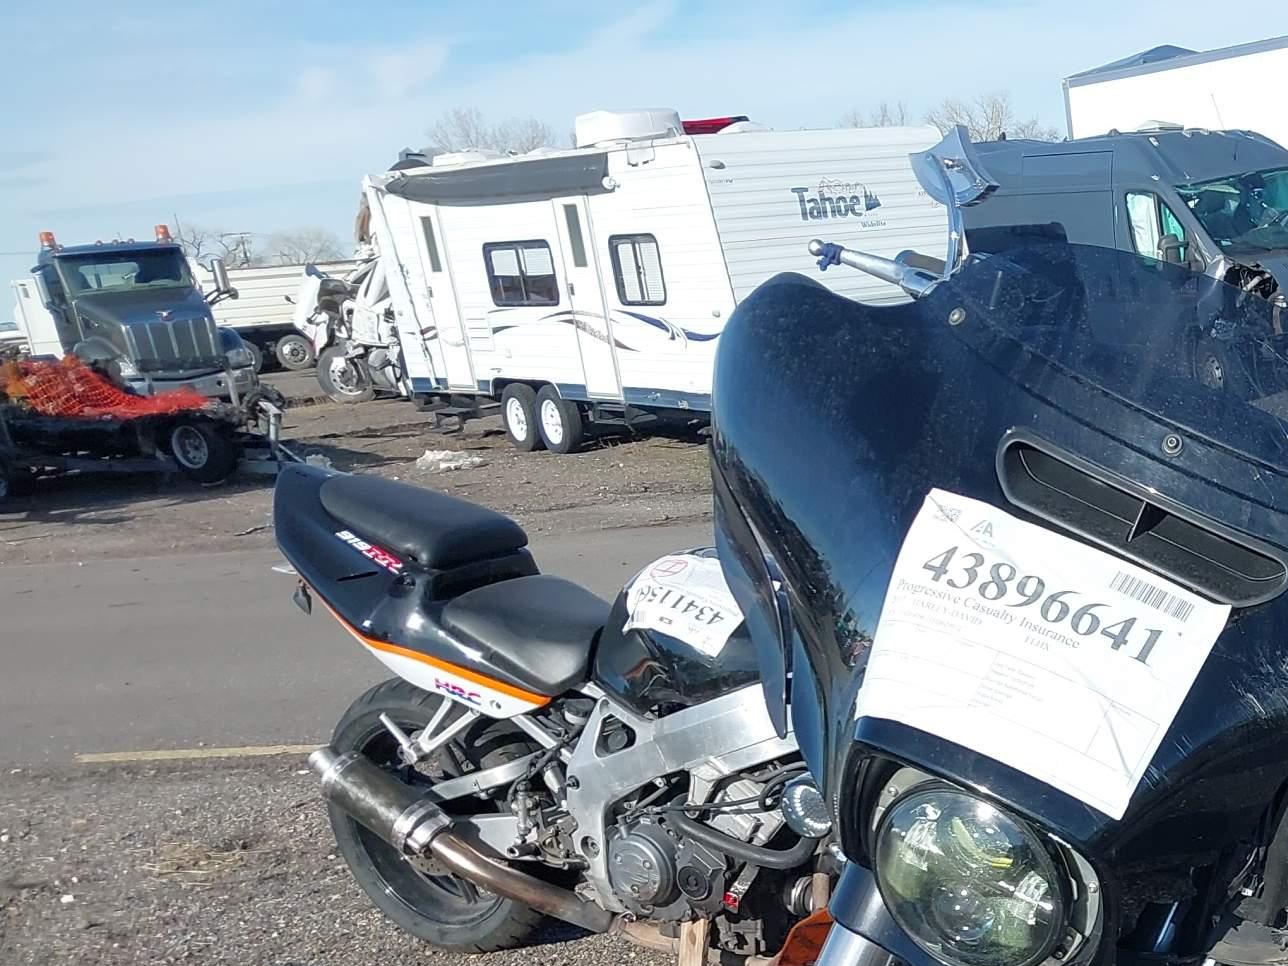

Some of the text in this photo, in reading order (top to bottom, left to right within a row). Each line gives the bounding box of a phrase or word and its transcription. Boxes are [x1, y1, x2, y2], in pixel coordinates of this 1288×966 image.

[790, 187, 864, 221] Tahoe
[896, 579, 961, 606] Progressive
[963, 597, 1017, 625] Casualty
[1018, 616, 1081, 650] Insurance
[922, 545, 1163, 667] 43896641
[434, 678, 482, 706] HRC
